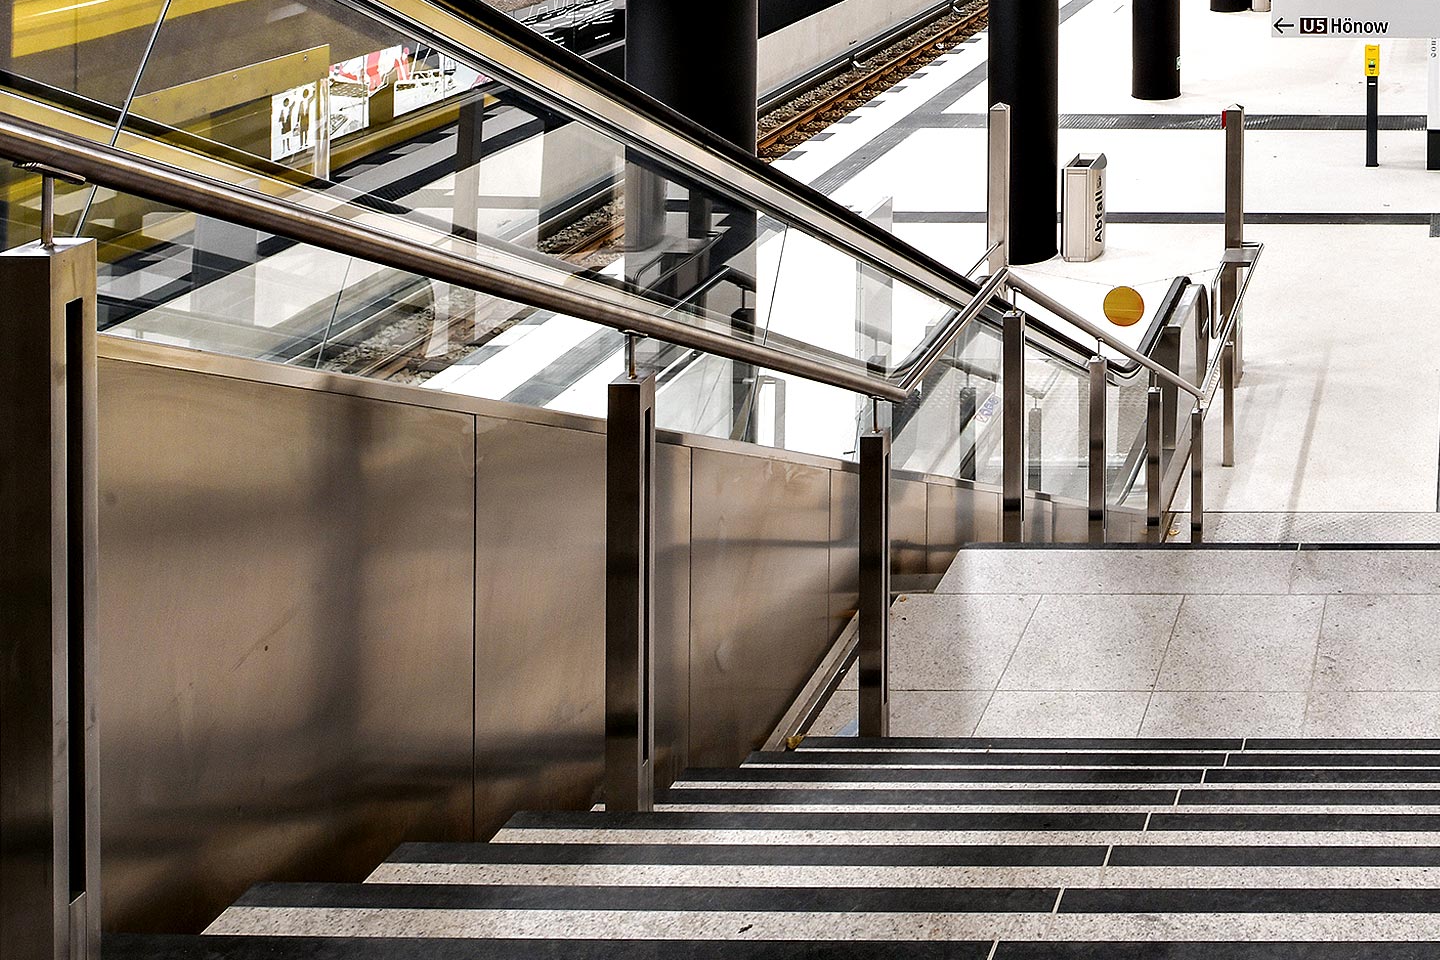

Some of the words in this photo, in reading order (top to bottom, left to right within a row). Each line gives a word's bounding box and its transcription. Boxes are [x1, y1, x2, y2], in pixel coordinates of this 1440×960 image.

[1302, 18, 1326, 33] U5
[1331, 17, 1389, 34] Hönow
[1094, 189, 1104, 243] Abfall
